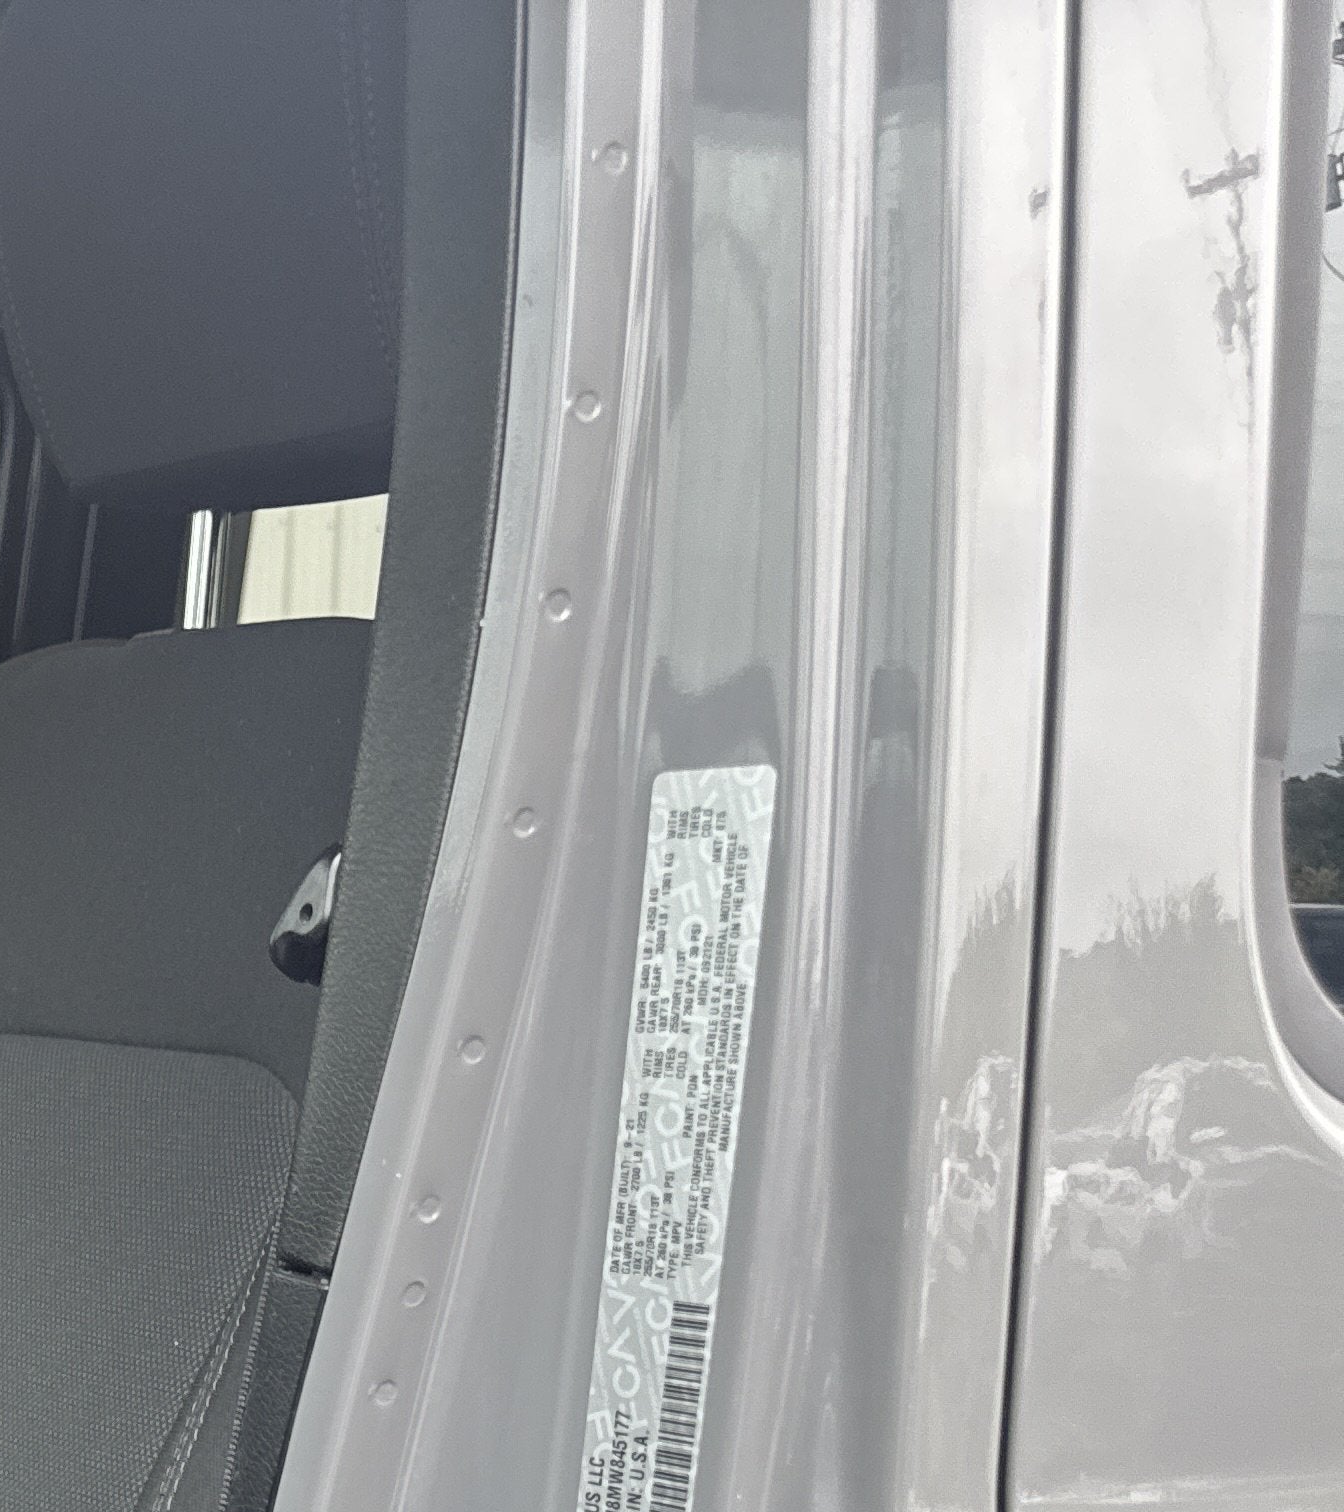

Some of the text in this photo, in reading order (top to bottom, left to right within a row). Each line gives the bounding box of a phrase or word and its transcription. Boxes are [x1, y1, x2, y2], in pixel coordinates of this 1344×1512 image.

[665, 809, 678, 839] WITH
[688, 805, 701, 838] TIRES
[723, 832, 739, 878] VEHICLE
[733, 863, 747, 892] DATE
[718, 882, 733, 922] MOTOR
[731, 896, 744, 919] THE
[712, 926, 728, 976] FEDERAL
[723, 942, 738, 983] EFFECT
[645, 999, 659, 1033] GAWR
[700, 1019, 718, 1085] APPLICABLE
[714, 1003, 732, 1071] STANDARDS
[640, 1048, 653, 1077] WITH
[652, 1050, 664, 1078] RIMS
[663, 1046, 676, 1078] TIRES
[675, 1050, 688, 1079] COLD
[698, 1090, 710, 1109] ALL
[717, 1068, 737, 1151] MANUFACTURE
[727, 1022, 742, 1065] SHOWN
[706, 1074, 724, 1143] PREVENTION
[689, 1130, 706, 1191] CONFORMS
[701, 1147, 716, 1182] THEFT
[620, 1241, 633, 1274] GAWR
[635, 1110, 647, 1134] 1225
[664, 1170, 675, 1188] PSI
[614, 1201, 626, 1224] MFR
[698, 1185, 711, 1210] AND
[670, 1220, 682, 1244] MPV
[683, 1194, 699, 1239] VEHICLE
[693, 1212, 708, 1255] SAFETY
[609, 1245, 622, 1273] DATE
[680, 1242, 693, 1267] THIS
[627, 1428, 649, 1480] U.S.A.
[586, 1455, 604, 1486] LLC
[624, 1485, 642, 1511] IN:
